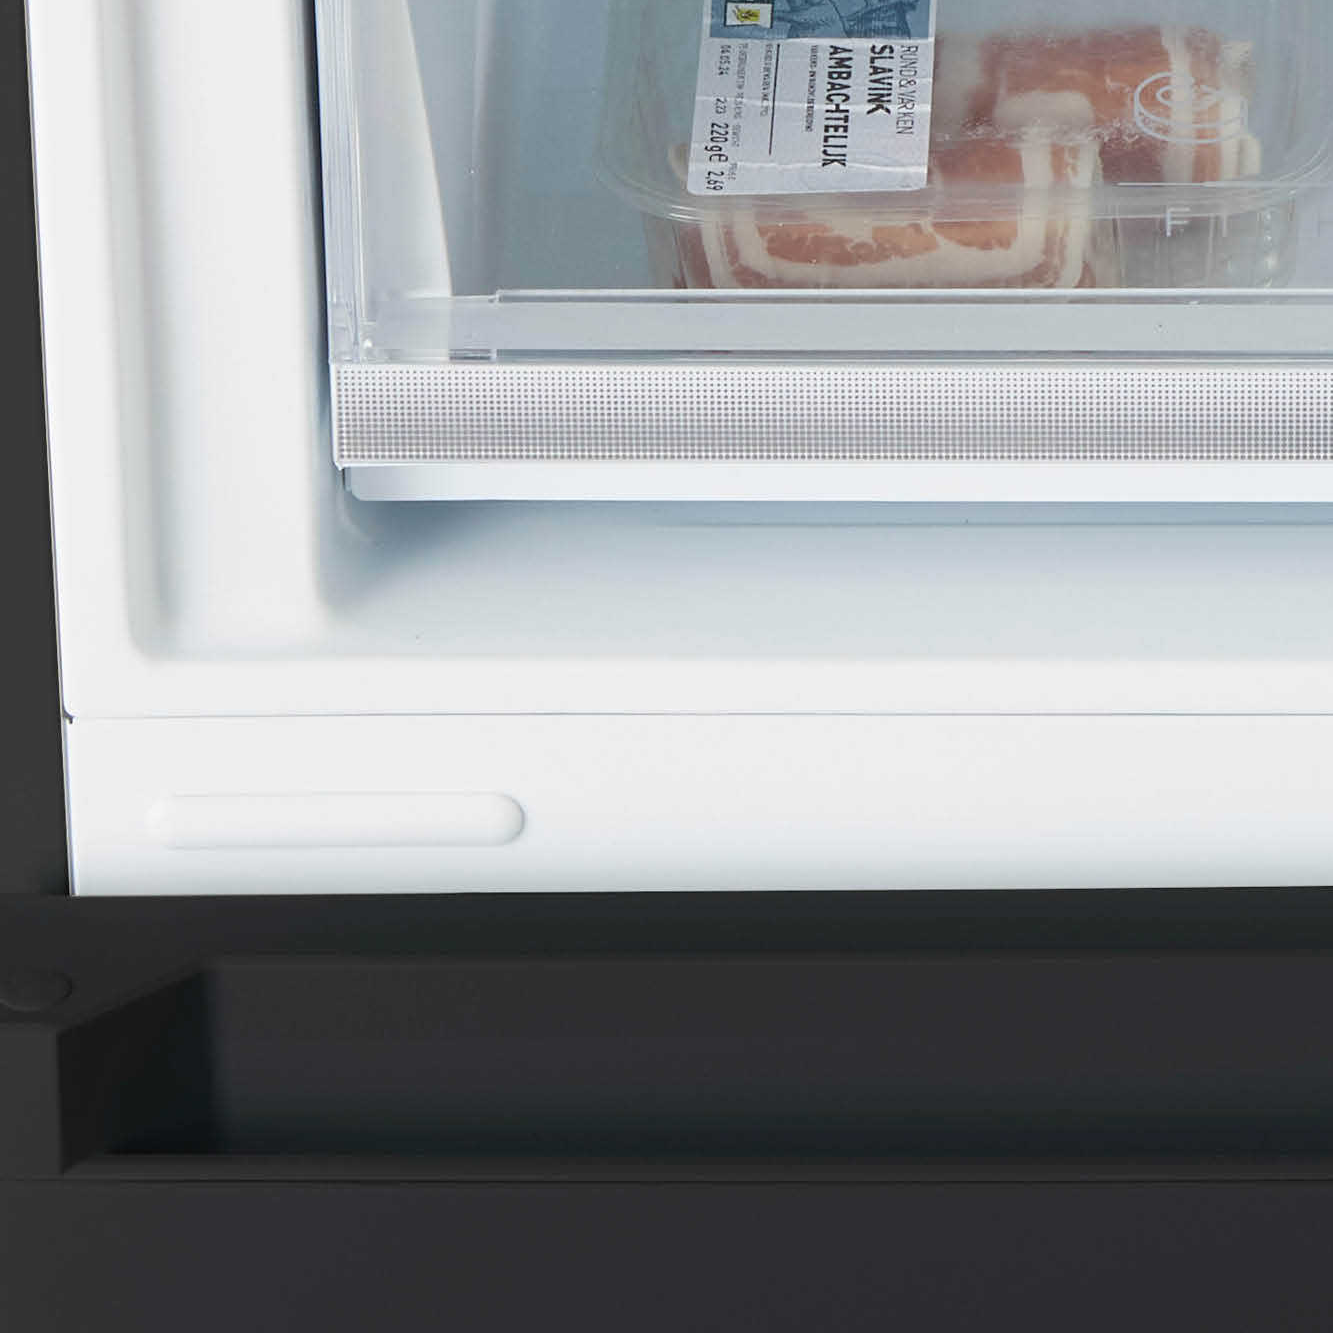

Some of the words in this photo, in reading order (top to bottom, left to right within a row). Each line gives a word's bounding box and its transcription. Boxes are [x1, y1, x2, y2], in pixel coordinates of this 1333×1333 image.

[866, 44, 894, 115] SLAVINK
[899, 45, 919, 77] RUND
[821, 44, 854, 168] AMBACHTELIJK
[710, 122, 728, 143] 220
